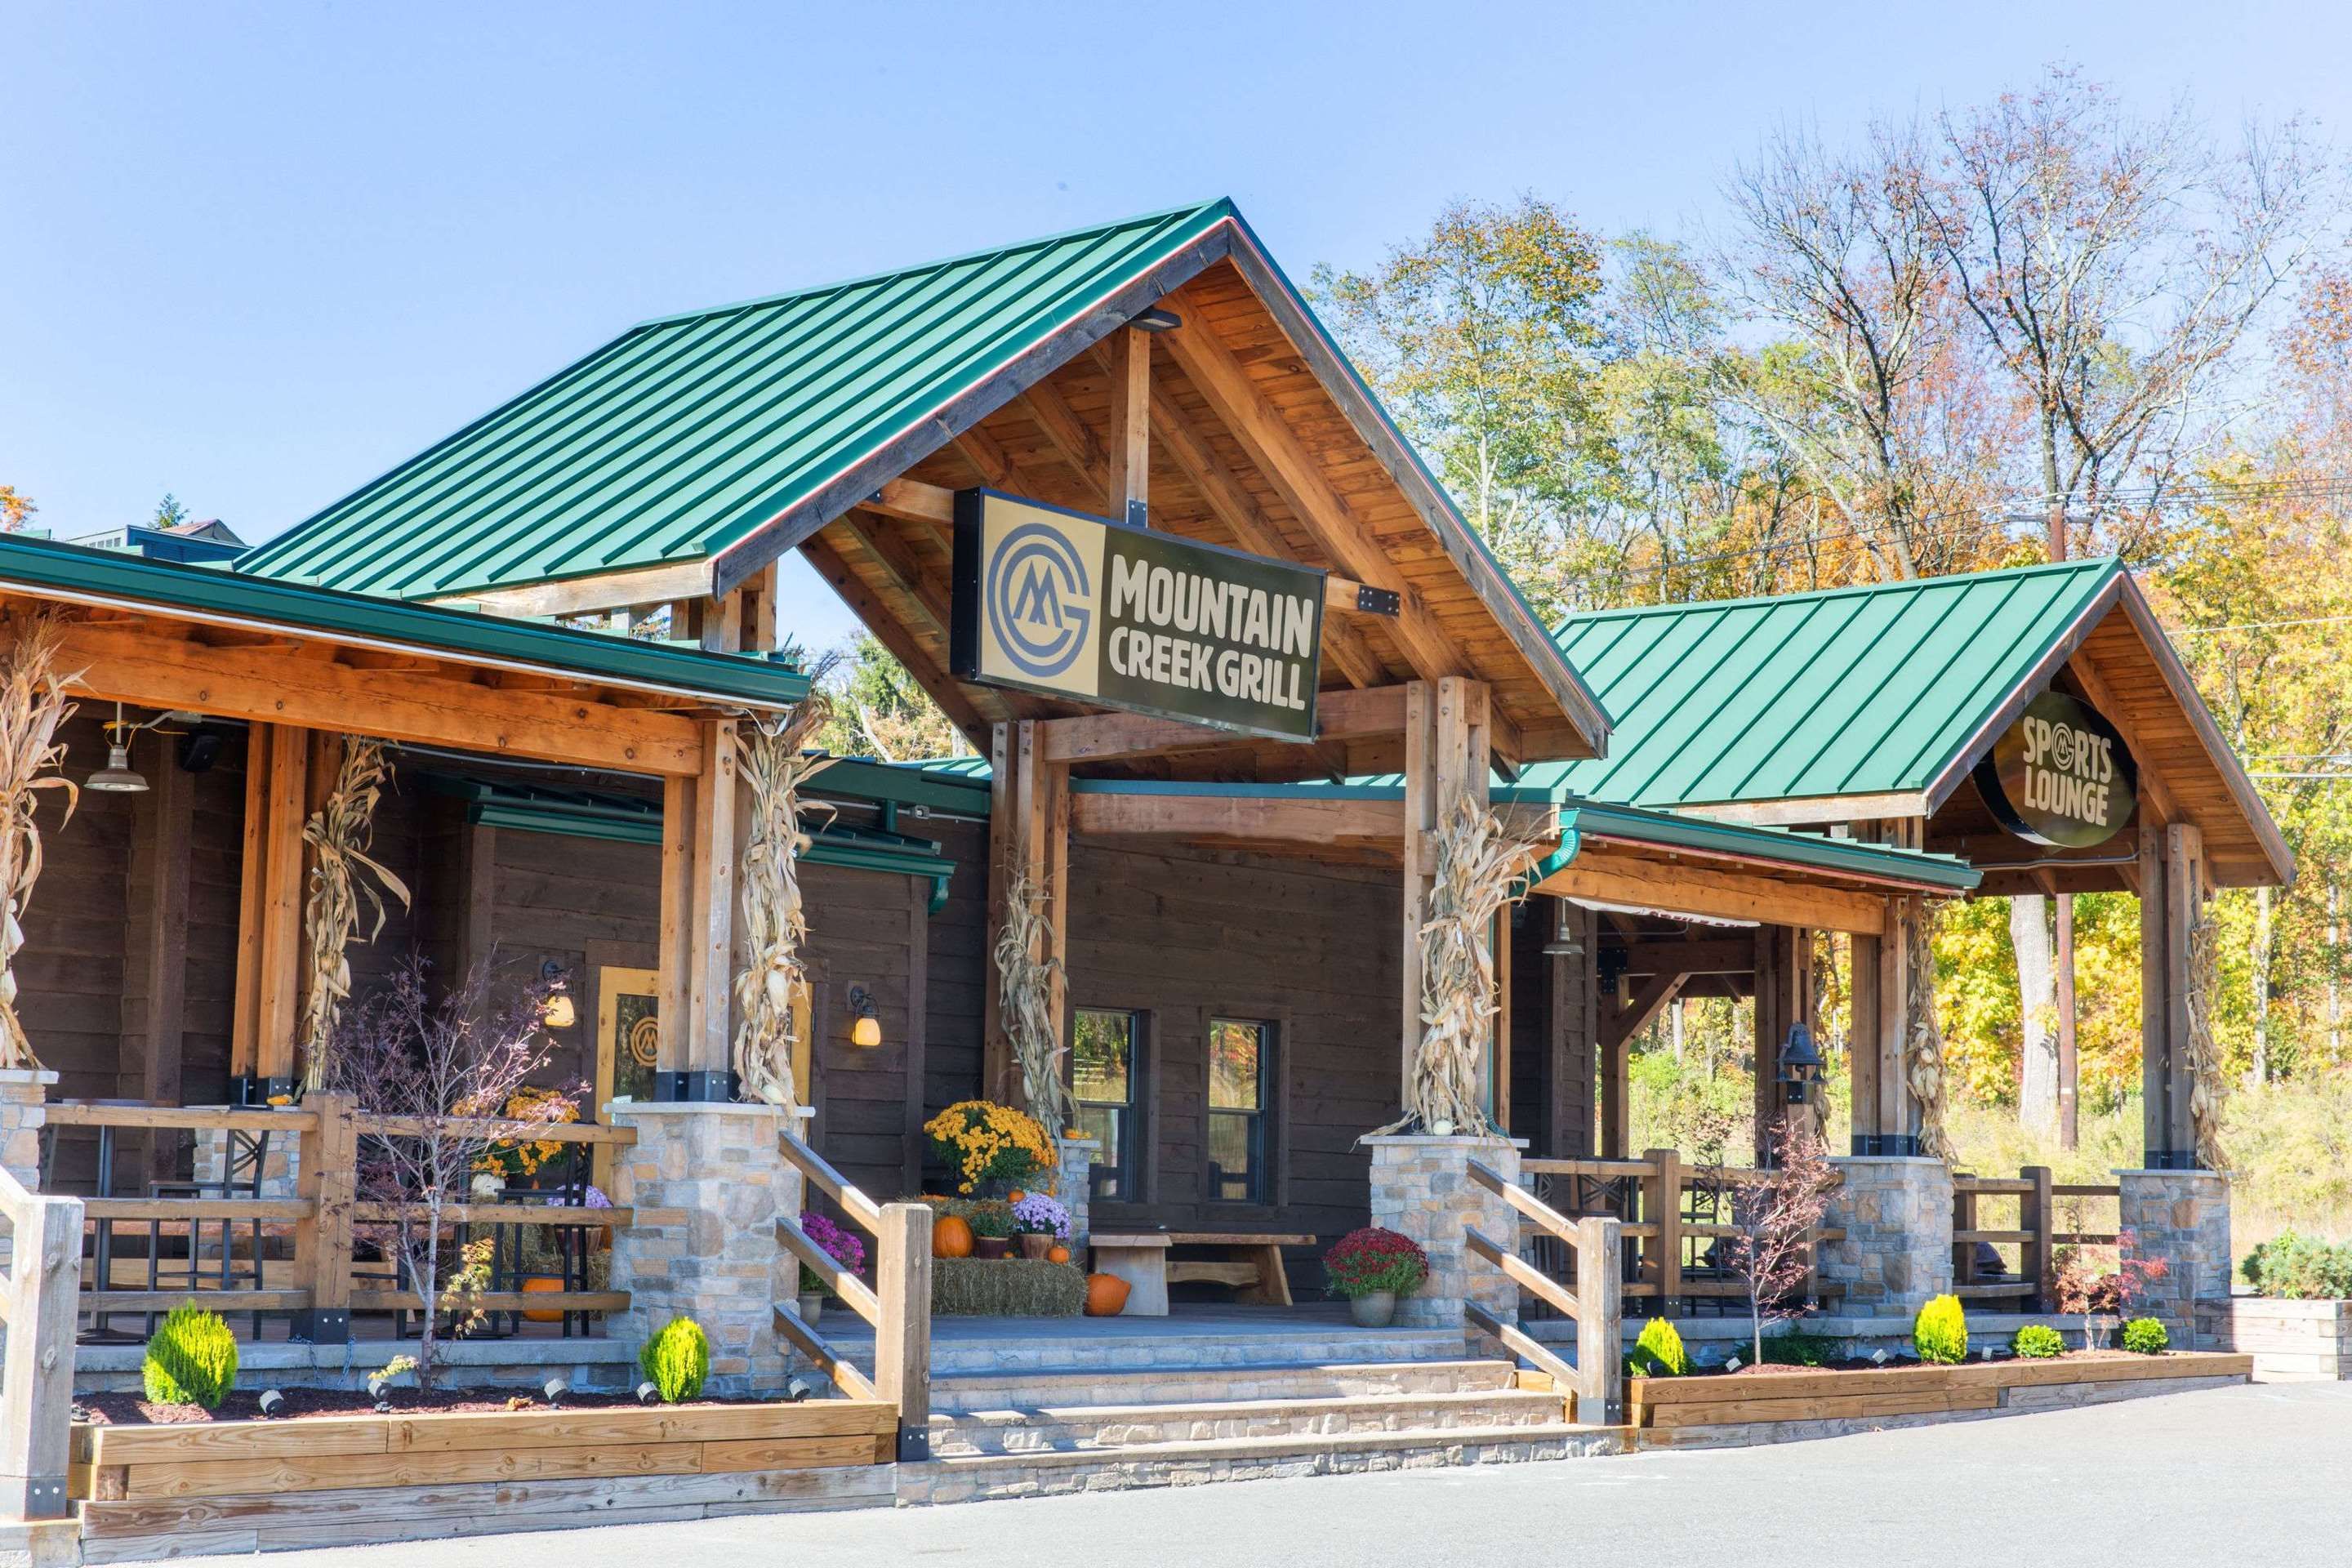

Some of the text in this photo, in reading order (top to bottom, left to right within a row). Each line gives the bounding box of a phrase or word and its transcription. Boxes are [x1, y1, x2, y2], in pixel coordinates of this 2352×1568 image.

[1110, 554, 1314, 658] MOUNTAIN
[1108, 626, 1306, 710] CREEK GRILL
[2022, 715, 2113, 784] SPORTS
[2024, 765, 2109, 827] LOUNGE
